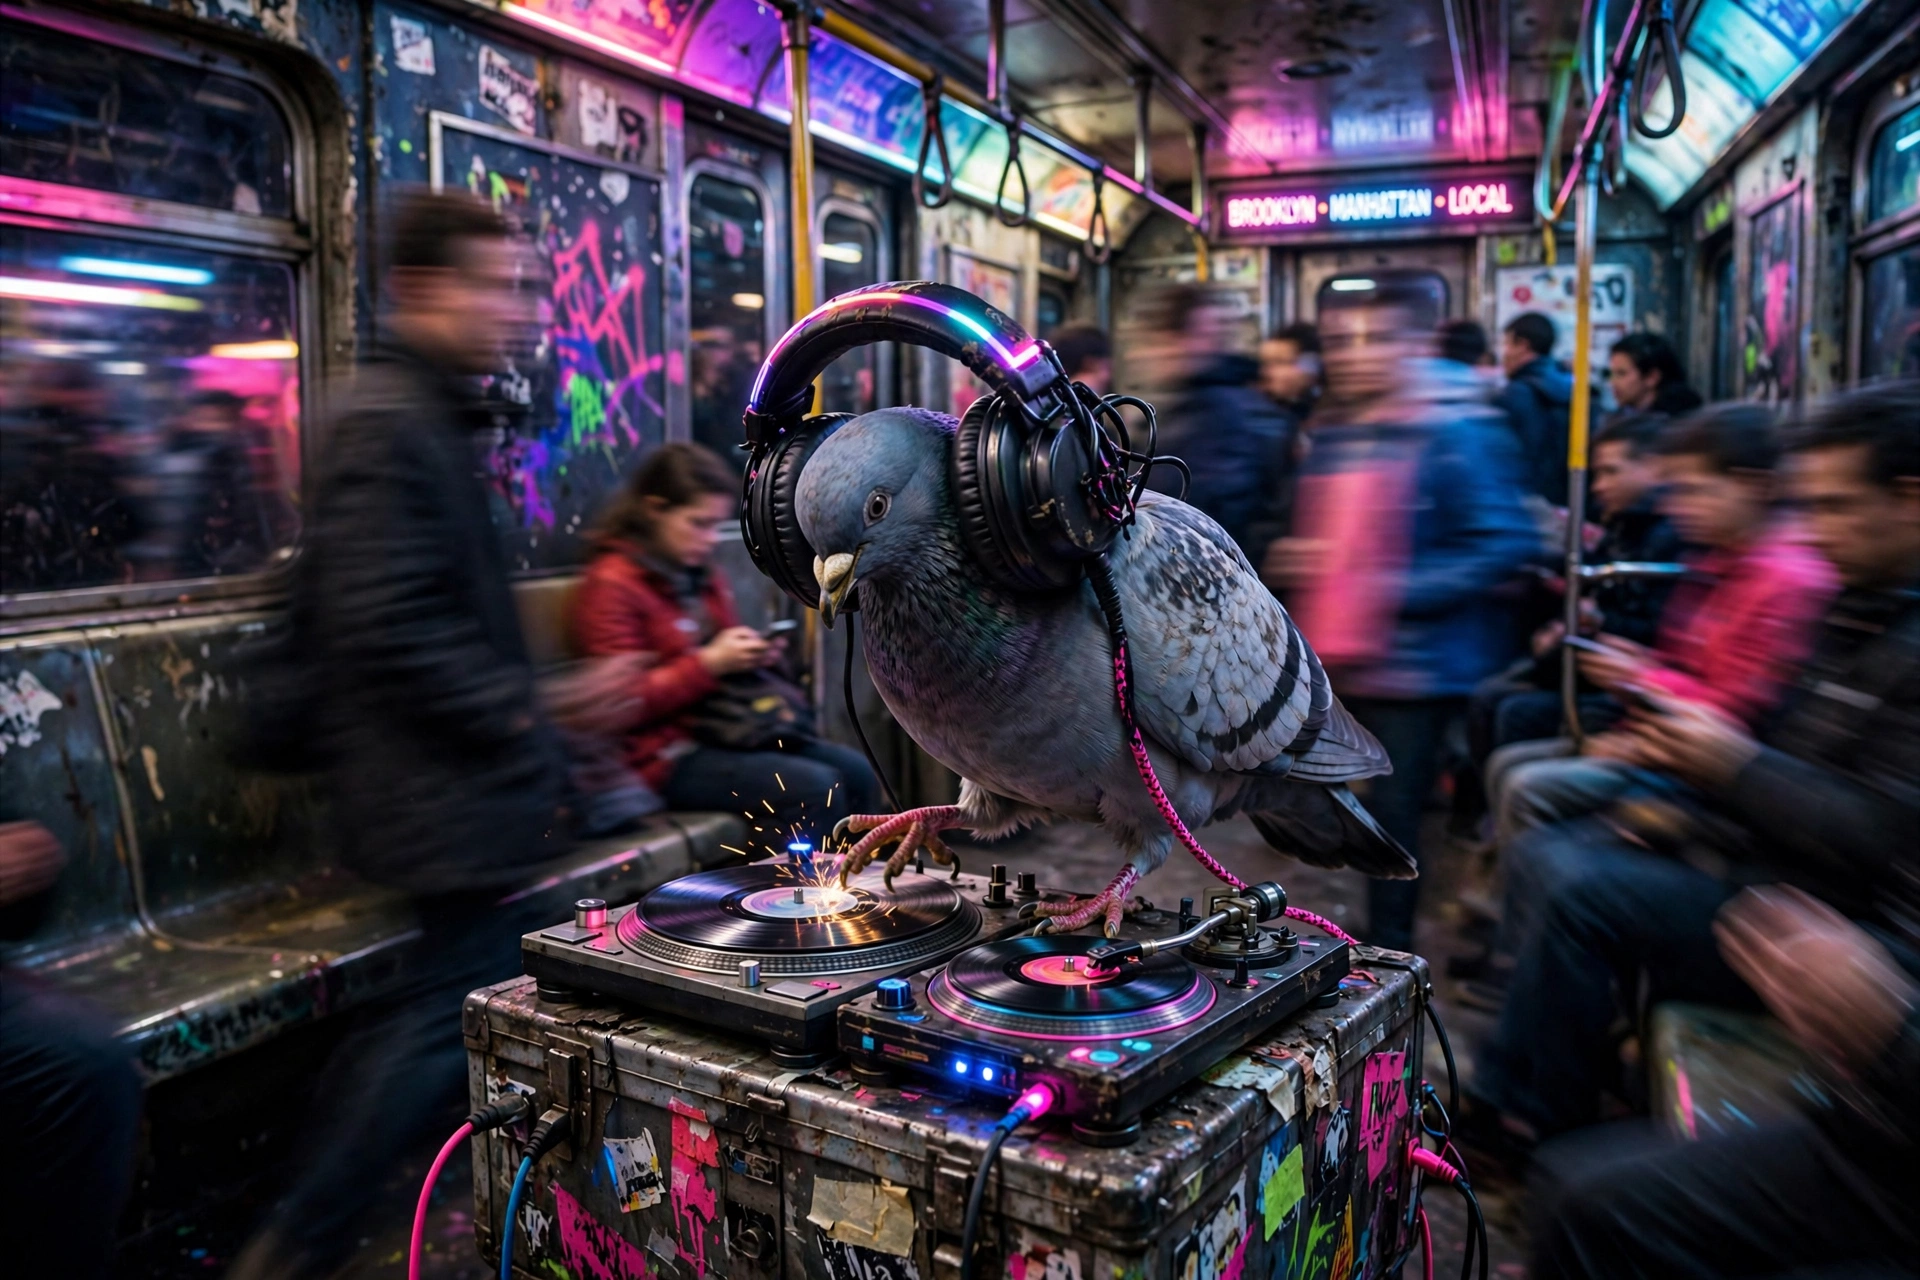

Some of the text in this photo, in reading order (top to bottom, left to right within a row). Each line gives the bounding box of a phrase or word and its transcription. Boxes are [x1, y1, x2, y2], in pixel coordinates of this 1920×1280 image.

[1228, 183, 1513, 227] BROOKLYN MANHATTAN LOCAL
